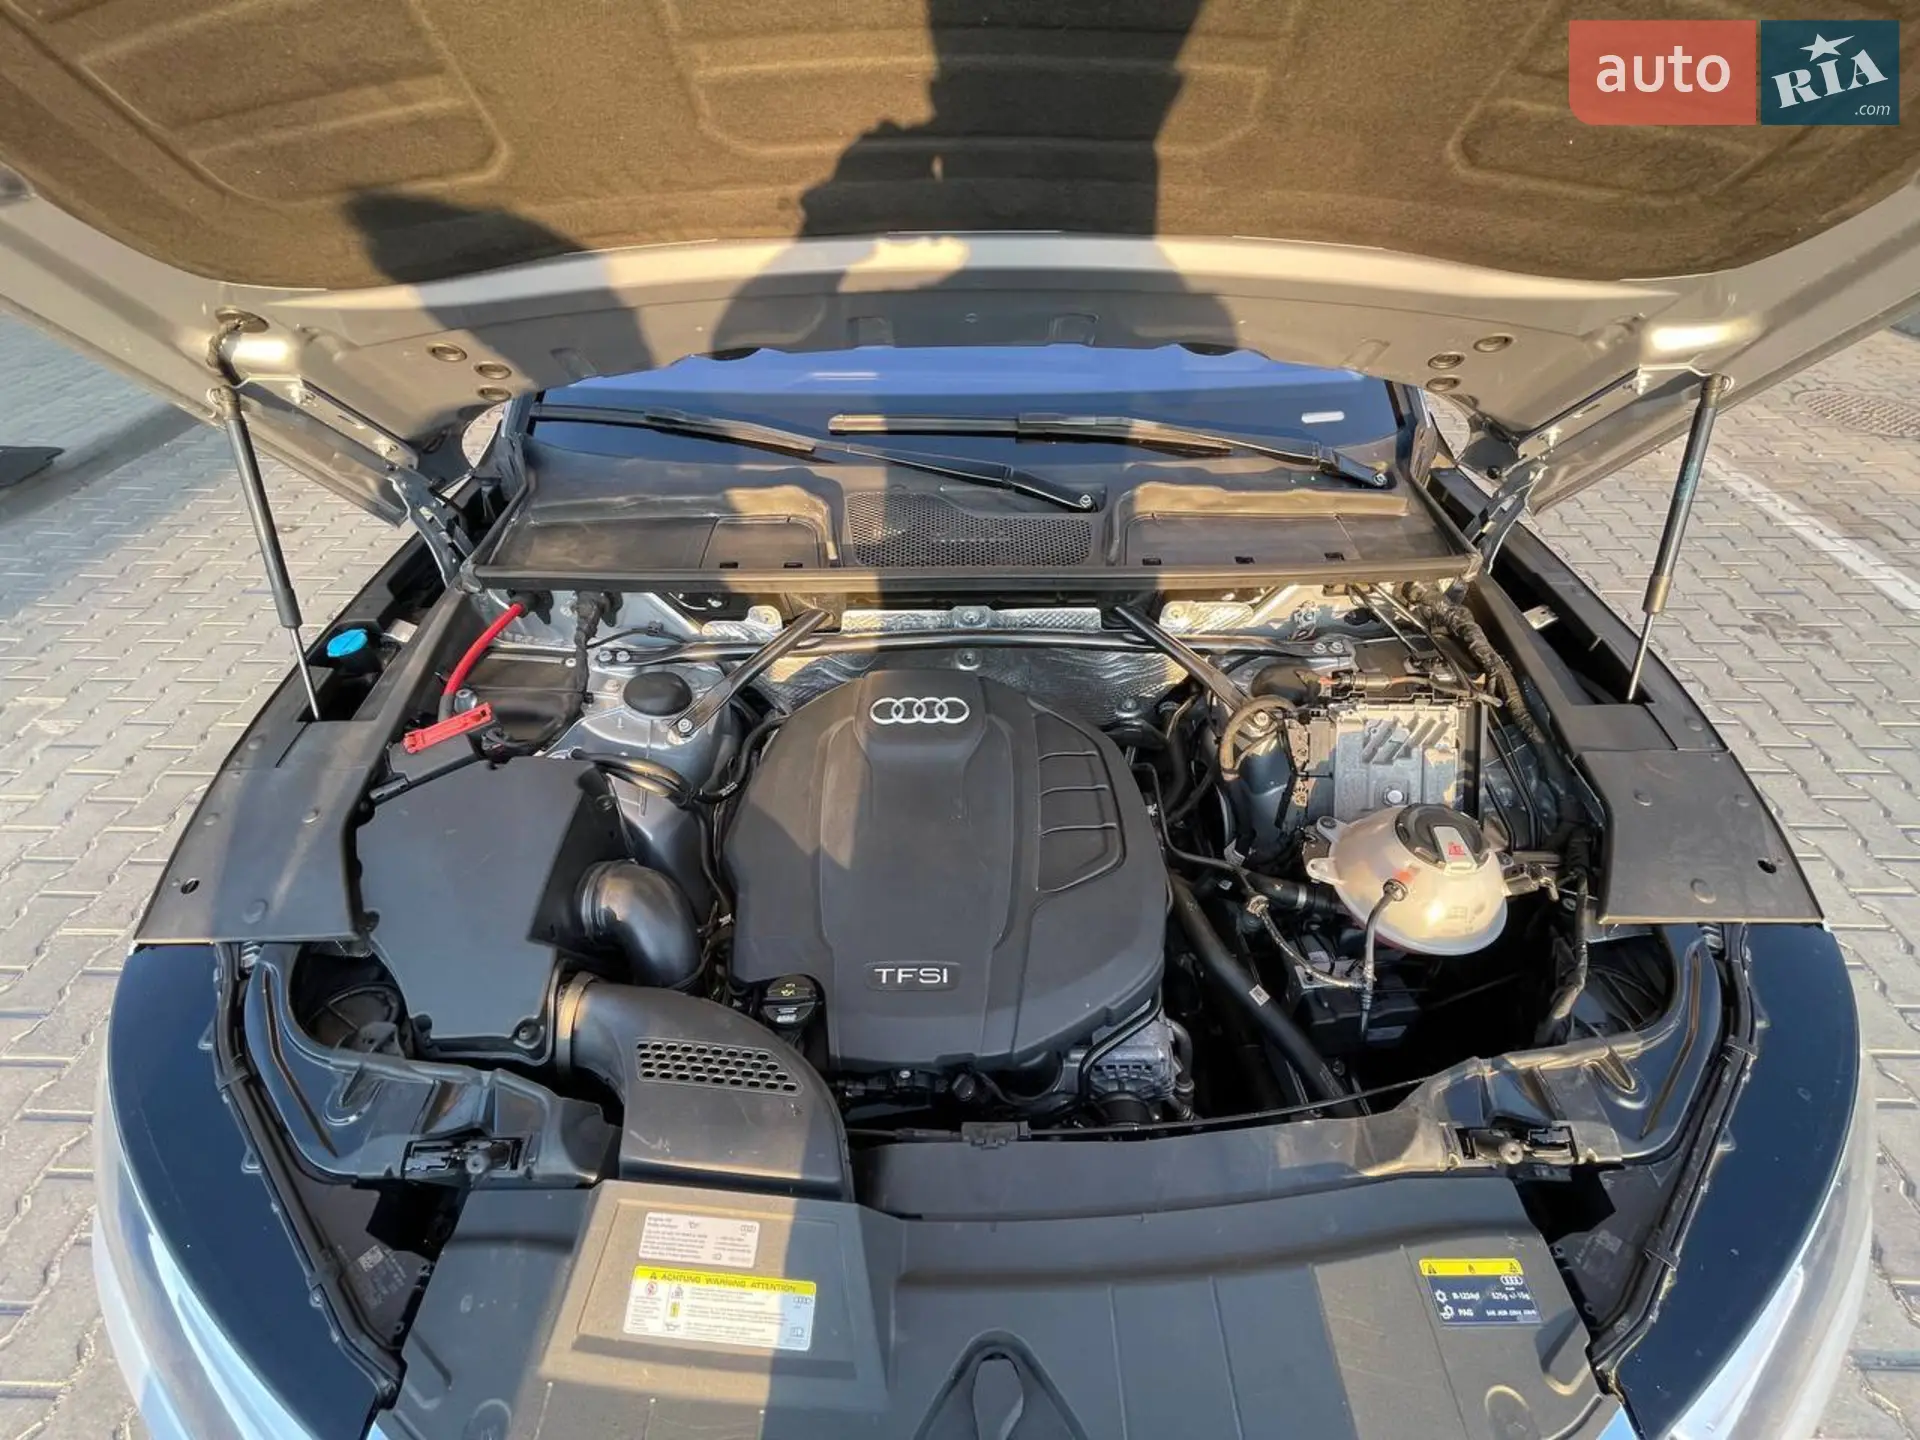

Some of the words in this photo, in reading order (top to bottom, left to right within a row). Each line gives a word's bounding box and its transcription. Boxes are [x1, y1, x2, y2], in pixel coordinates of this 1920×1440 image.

[874, 968, 948, 984] TFSI
[661, 1273, 701, 1284] ACHTUNG
[705, 1277, 746, 1288] WARNING
[750, 1281, 797, 1293] ATTENTION
